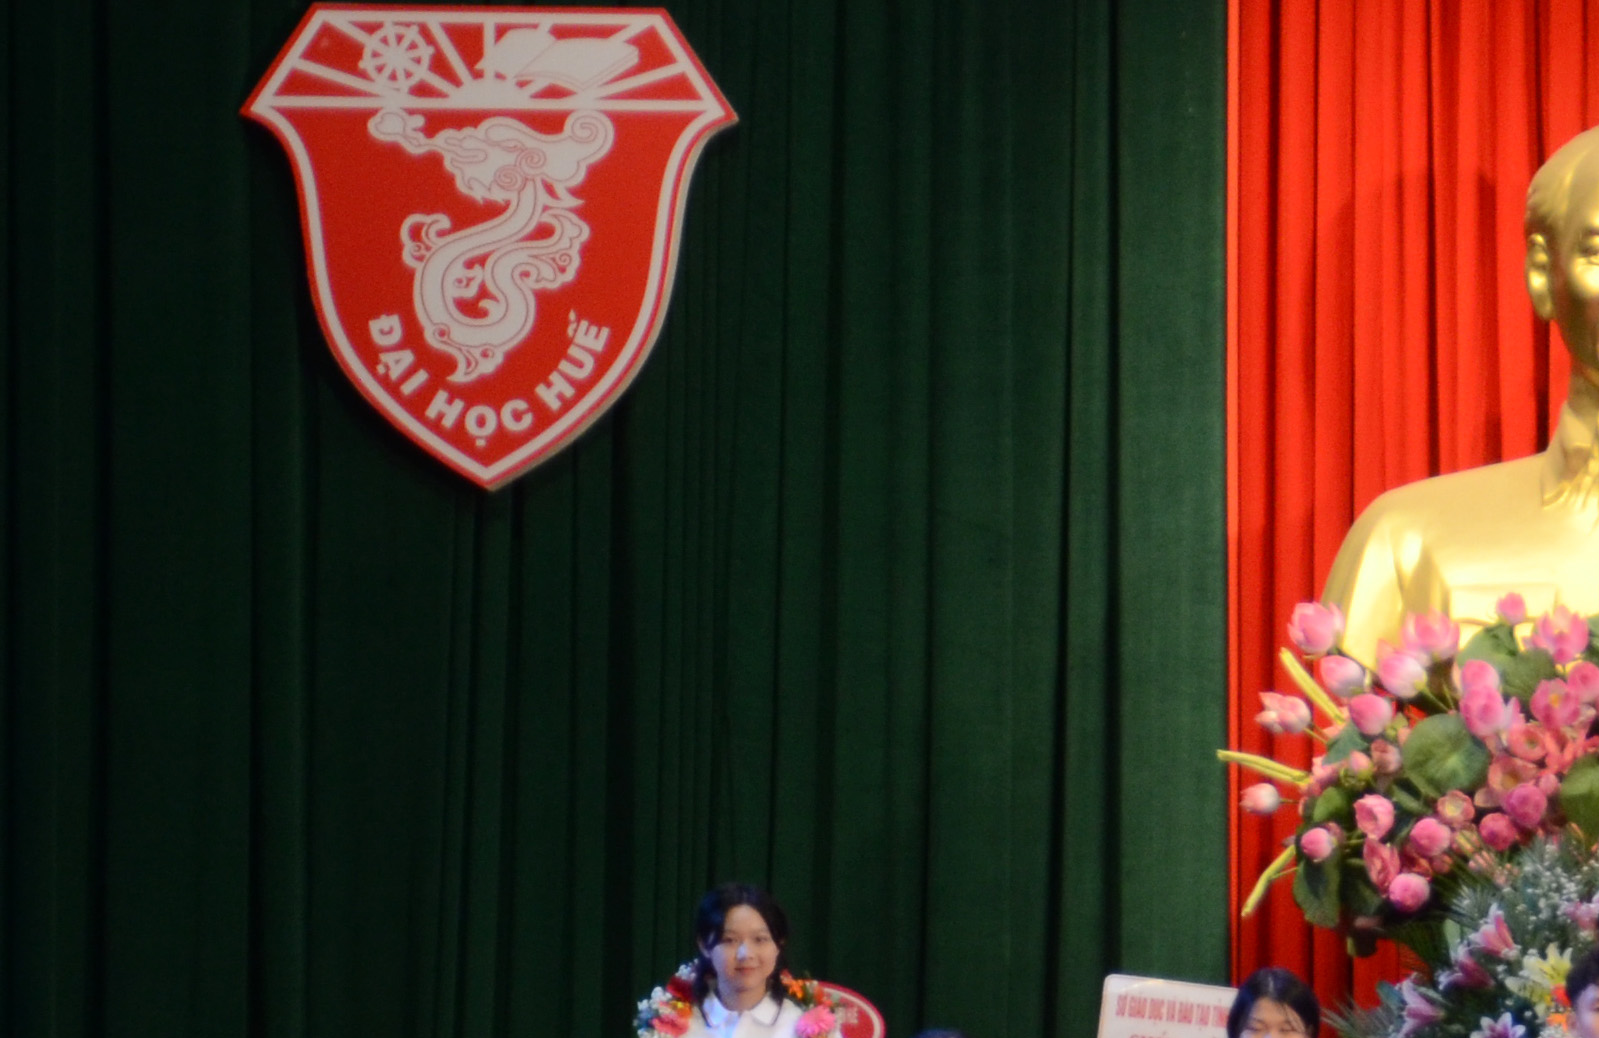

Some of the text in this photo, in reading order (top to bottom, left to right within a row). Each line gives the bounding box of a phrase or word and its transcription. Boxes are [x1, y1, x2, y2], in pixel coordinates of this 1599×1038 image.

[368, 308, 611, 447] ĐẠI HỌC HUẾ
